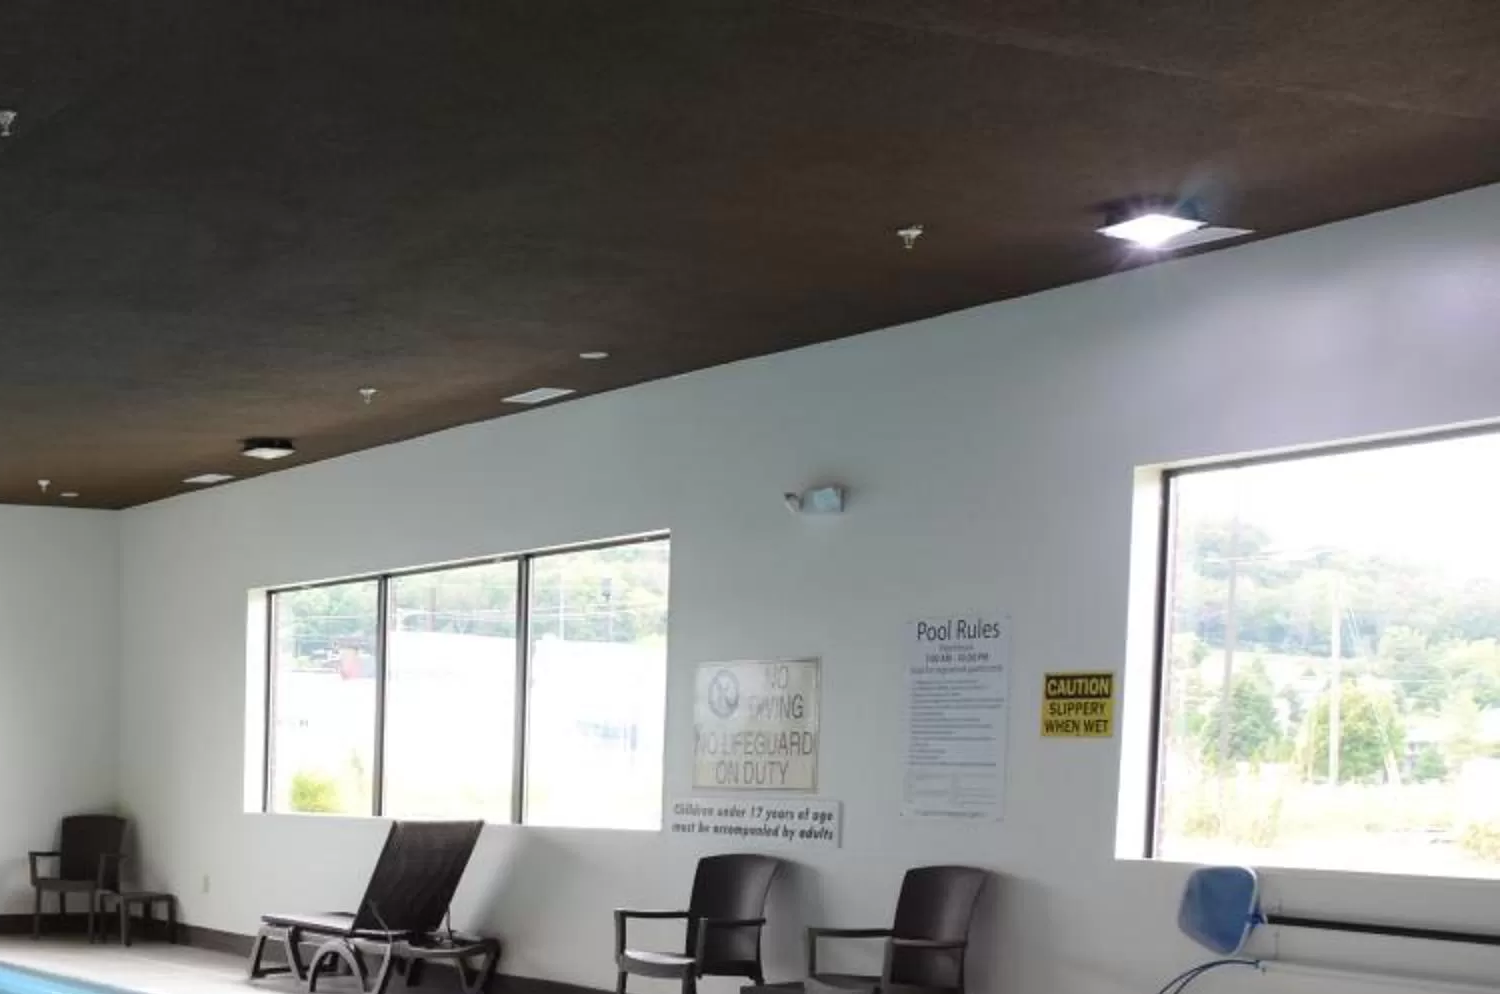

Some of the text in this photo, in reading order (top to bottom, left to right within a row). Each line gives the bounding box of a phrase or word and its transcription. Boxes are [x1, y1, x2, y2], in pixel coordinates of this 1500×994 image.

[917, 617, 1000, 641] Pool Rules
[1047, 677, 1109, 697] CAUTION
[1048, 701, 1106, 716] SLIPPERY
[1044, 719, 1109, 733] WHEN WET
[721, 731, 813, 756] LIFEGUARD
[715, 760, 790, 785] ON DUTY
[674, 803, 833, 825] Children under 17 years of age
[671, 820, 833, 842] must be accompanied by adults
